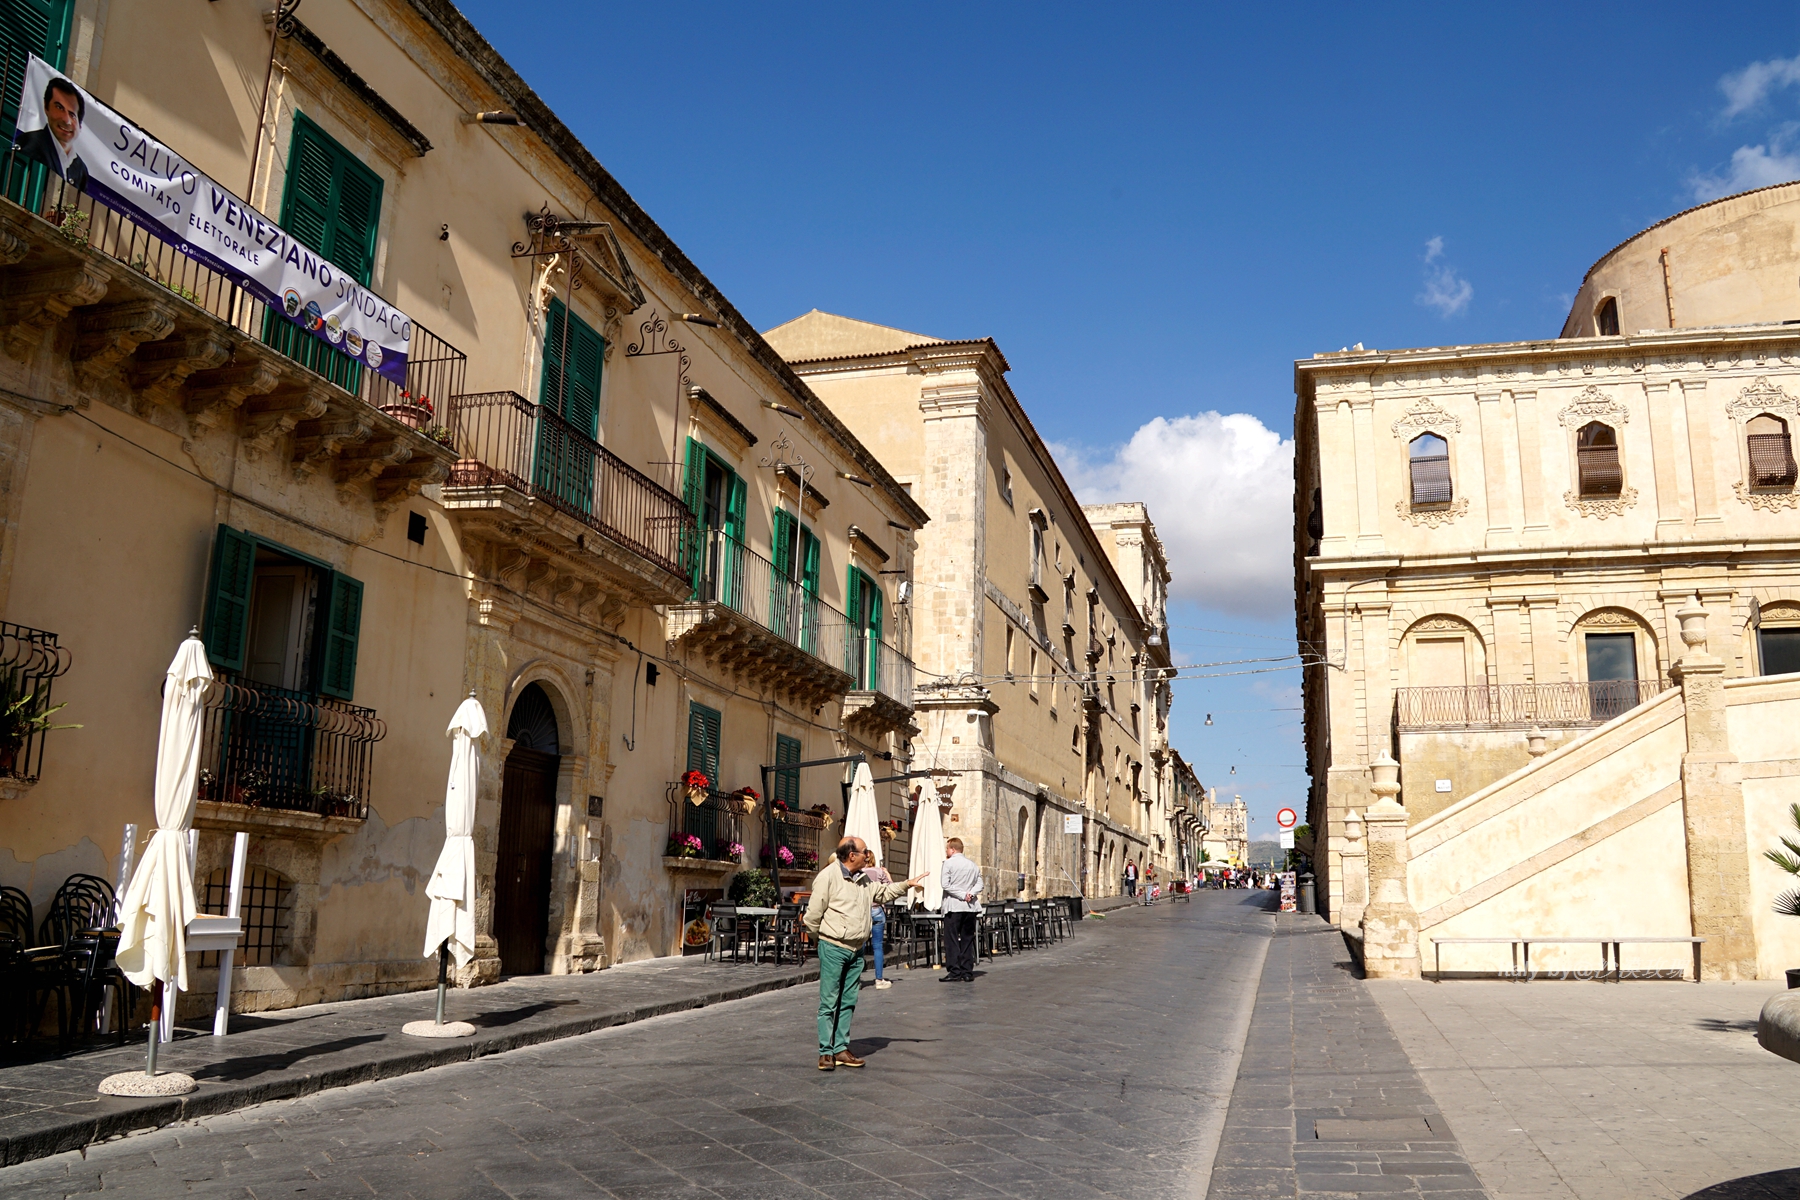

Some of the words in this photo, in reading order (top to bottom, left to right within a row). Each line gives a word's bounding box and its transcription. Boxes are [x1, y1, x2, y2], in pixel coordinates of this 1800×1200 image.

[110, 160, 182, 215] COMITATO
[188, 212, 260, 266] ELETTORALE
[113, 124, 196, 196] SALVO
[211, 186, 332, 288] VENEZIANO
[335, 277, 411, 342] SINDACO
